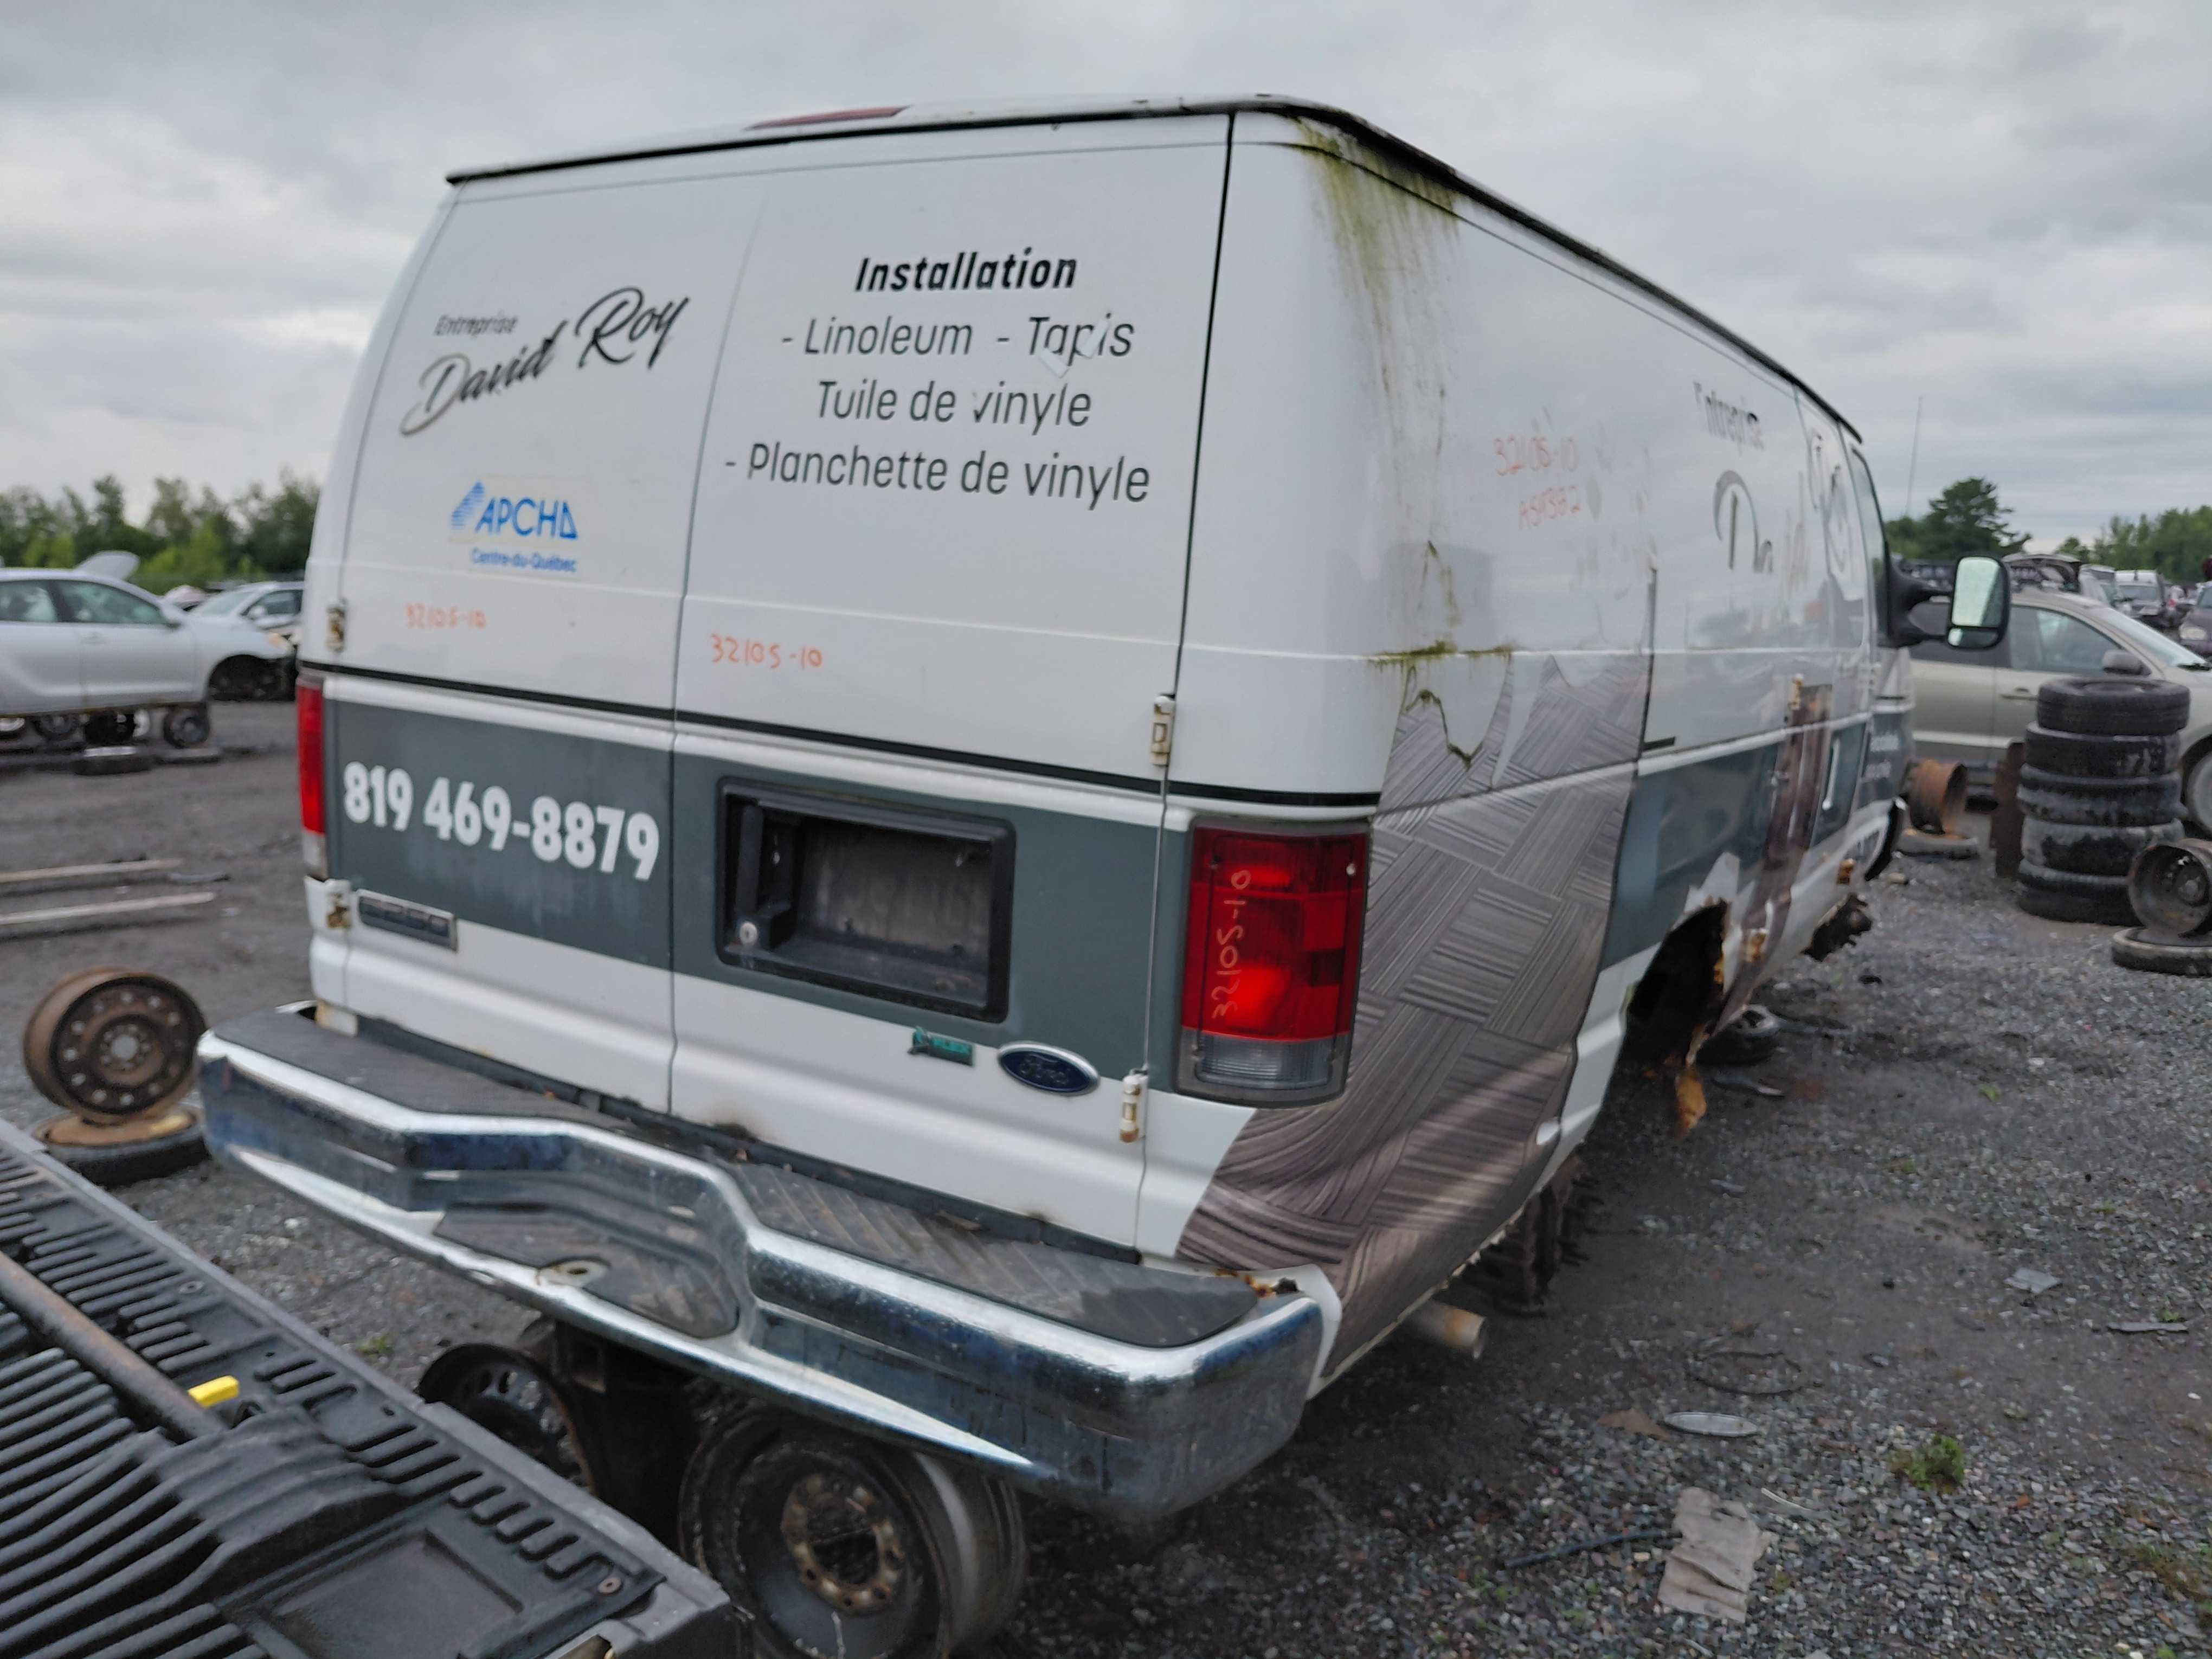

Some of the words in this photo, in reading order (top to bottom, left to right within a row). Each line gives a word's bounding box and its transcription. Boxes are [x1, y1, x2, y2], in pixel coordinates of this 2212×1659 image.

[853, 247, 1078, 293] Installation
[399, 319, 569, 437] David
[575, 287, 690, 370] Roy
[804, 314, 974, 356] Linoleum
[1028, 312, 1135, 367] Tapis
[819, 378, 897, 421] Tuile
[910, 380, 956, 423] de
[973, 380, 1092, 436] vinyle
[748, 441, 948, 492] Planchette
[960, 450, 1010, 496] de
[1024, 452, 1151, 511] vinyle
[343, 761, 413, 831] 819
[423, 776, 660, 882] 469-8879
